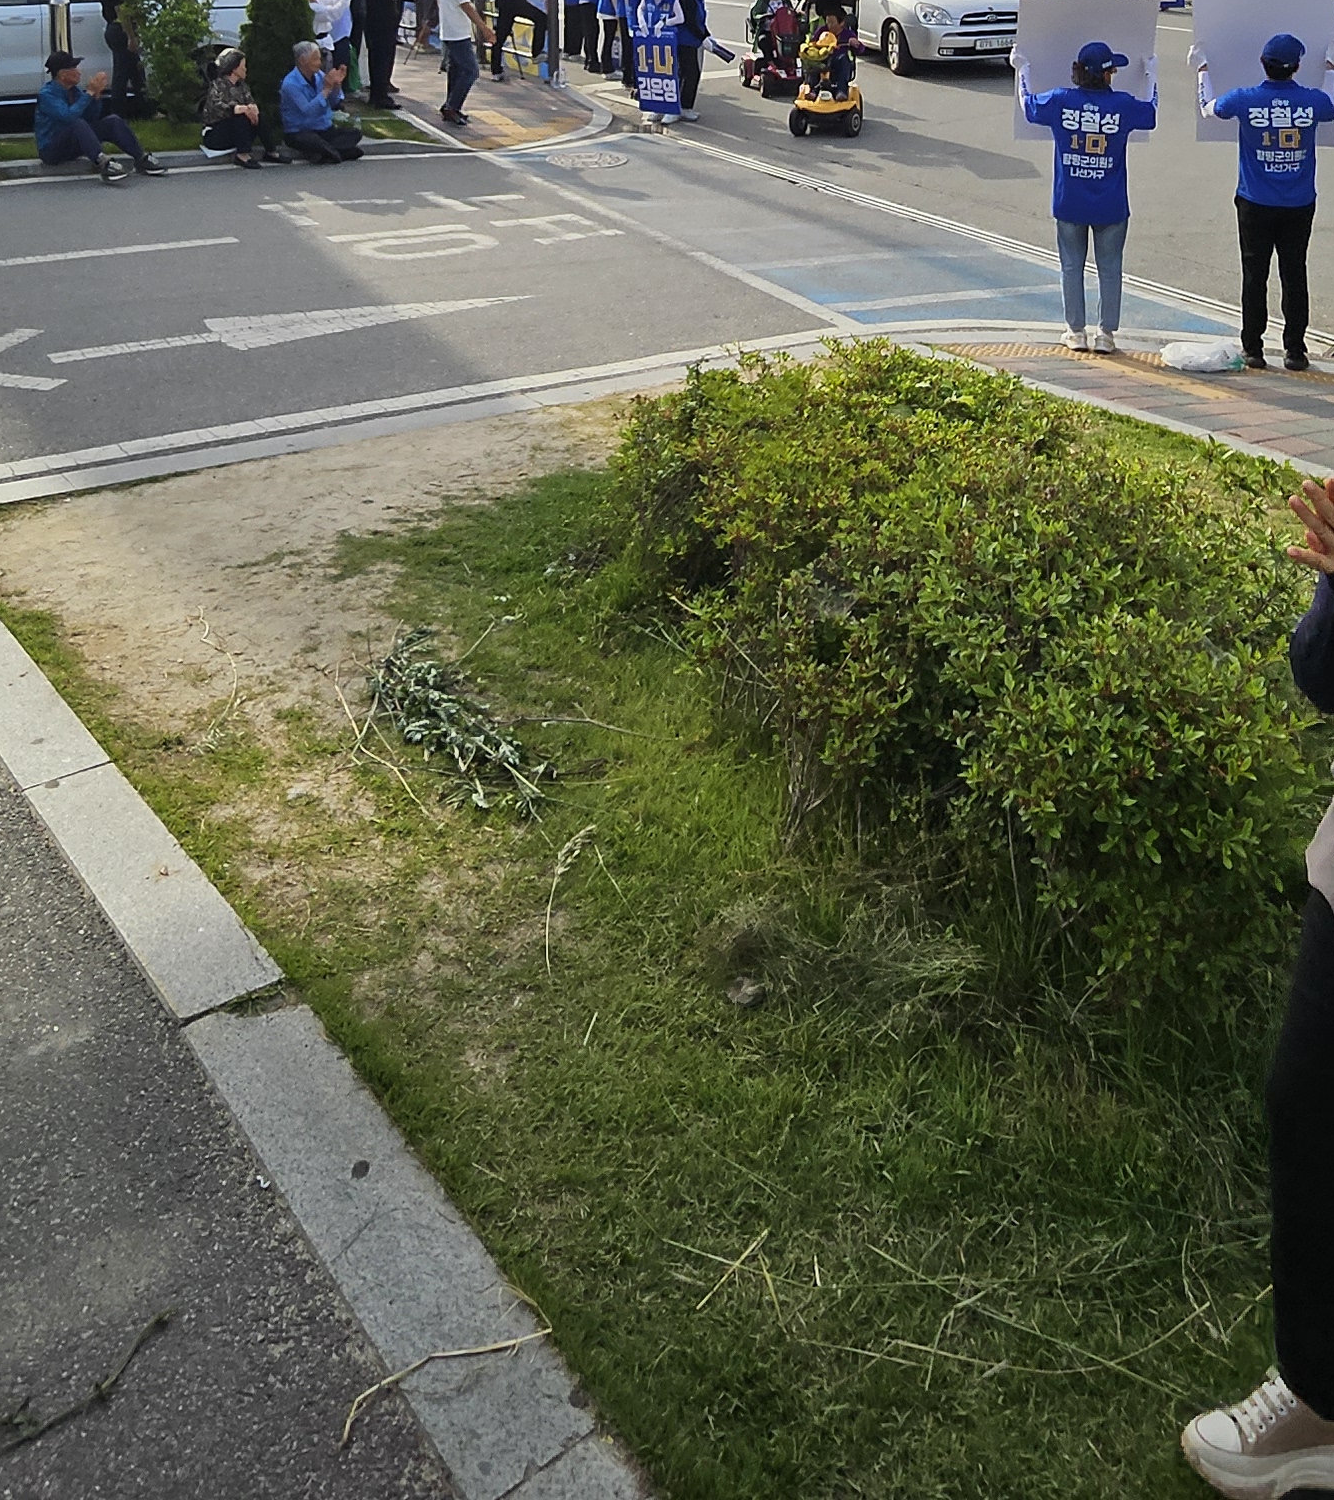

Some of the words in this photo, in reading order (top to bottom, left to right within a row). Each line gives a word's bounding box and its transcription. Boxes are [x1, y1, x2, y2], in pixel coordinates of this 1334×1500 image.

[637, 77, 678, 103] 김은영
[1061, 108, 1121, 134] 정철성
[1248, 107, 1314, 128] 정철성
